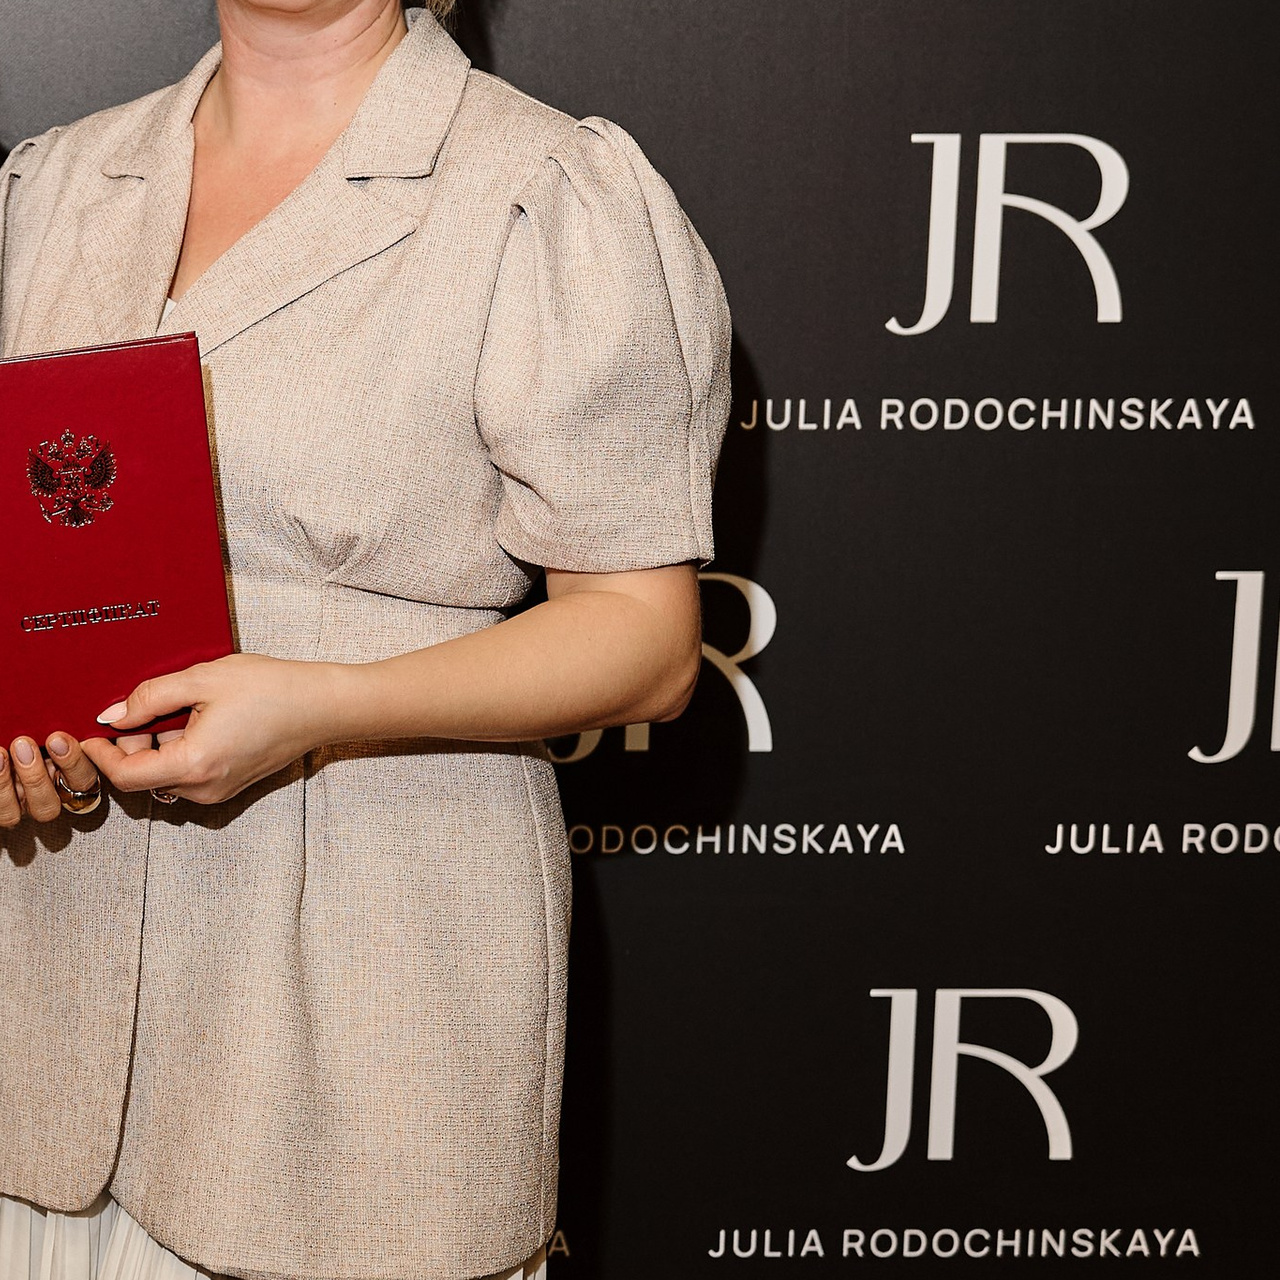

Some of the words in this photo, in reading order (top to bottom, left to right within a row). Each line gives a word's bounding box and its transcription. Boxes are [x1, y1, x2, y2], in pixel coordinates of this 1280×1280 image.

[885, 133, 1129, 336] JR
[741, 398, 862, 431] JULIA
[881, 398, 1255, 431] RODOCHINSKAYA
[21, 600, 160, 632] СЕРТИФИКАТ
[1187, 571, 1280, 764] J
[1045, 823, 1163, 855] JULIA
[1182, 823, 1280, 854] ROD
[847, 988, 1079, 1172] JR
[708, 1229, 824, 1258] JULIA
[842, 1229, 1200, 1258] RODOCHINSKAYA
